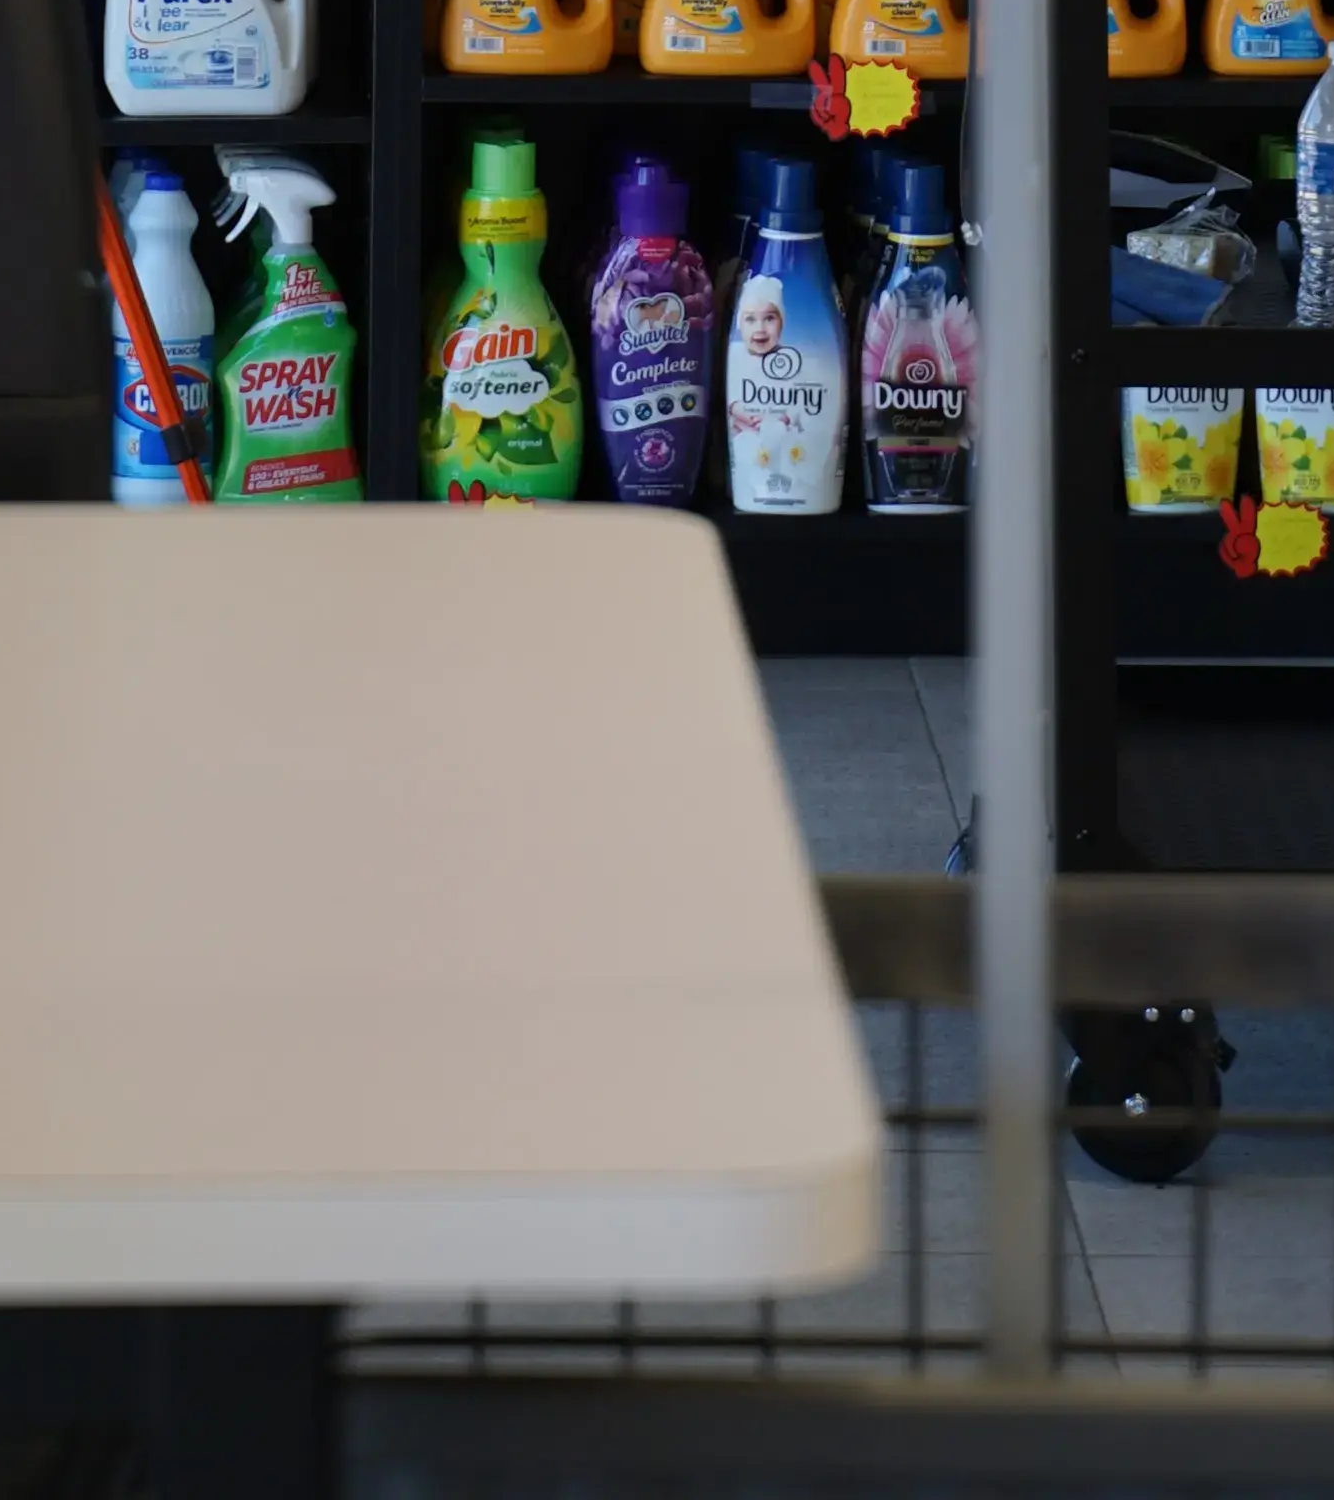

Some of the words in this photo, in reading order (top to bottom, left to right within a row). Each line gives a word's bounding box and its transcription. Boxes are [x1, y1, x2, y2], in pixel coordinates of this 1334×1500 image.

[1260, 10, 1289, 22] CLEAN
[1267, 3, 1284, 12] OXI
[128, 47, 148, 59] 38
[286, 263, 316, 286] 1ST
[283, 281, 321, 298] TIME
[442, 326, 537, 371] Gain
[620, 325, 689, 355] Suavitel
[240, 355, 337, 393] SPRAY
[611, 358, 696, 386] Complete
[245, 389, 337, 425] WASH
[743, 379, 826, 414] Downy
[875, 382, 965, 418] Downy
[507, 440, 542, 448] original
[273, 464, 319, 476] EVERYDAY
[256, 477, 290, 489] GREASY
